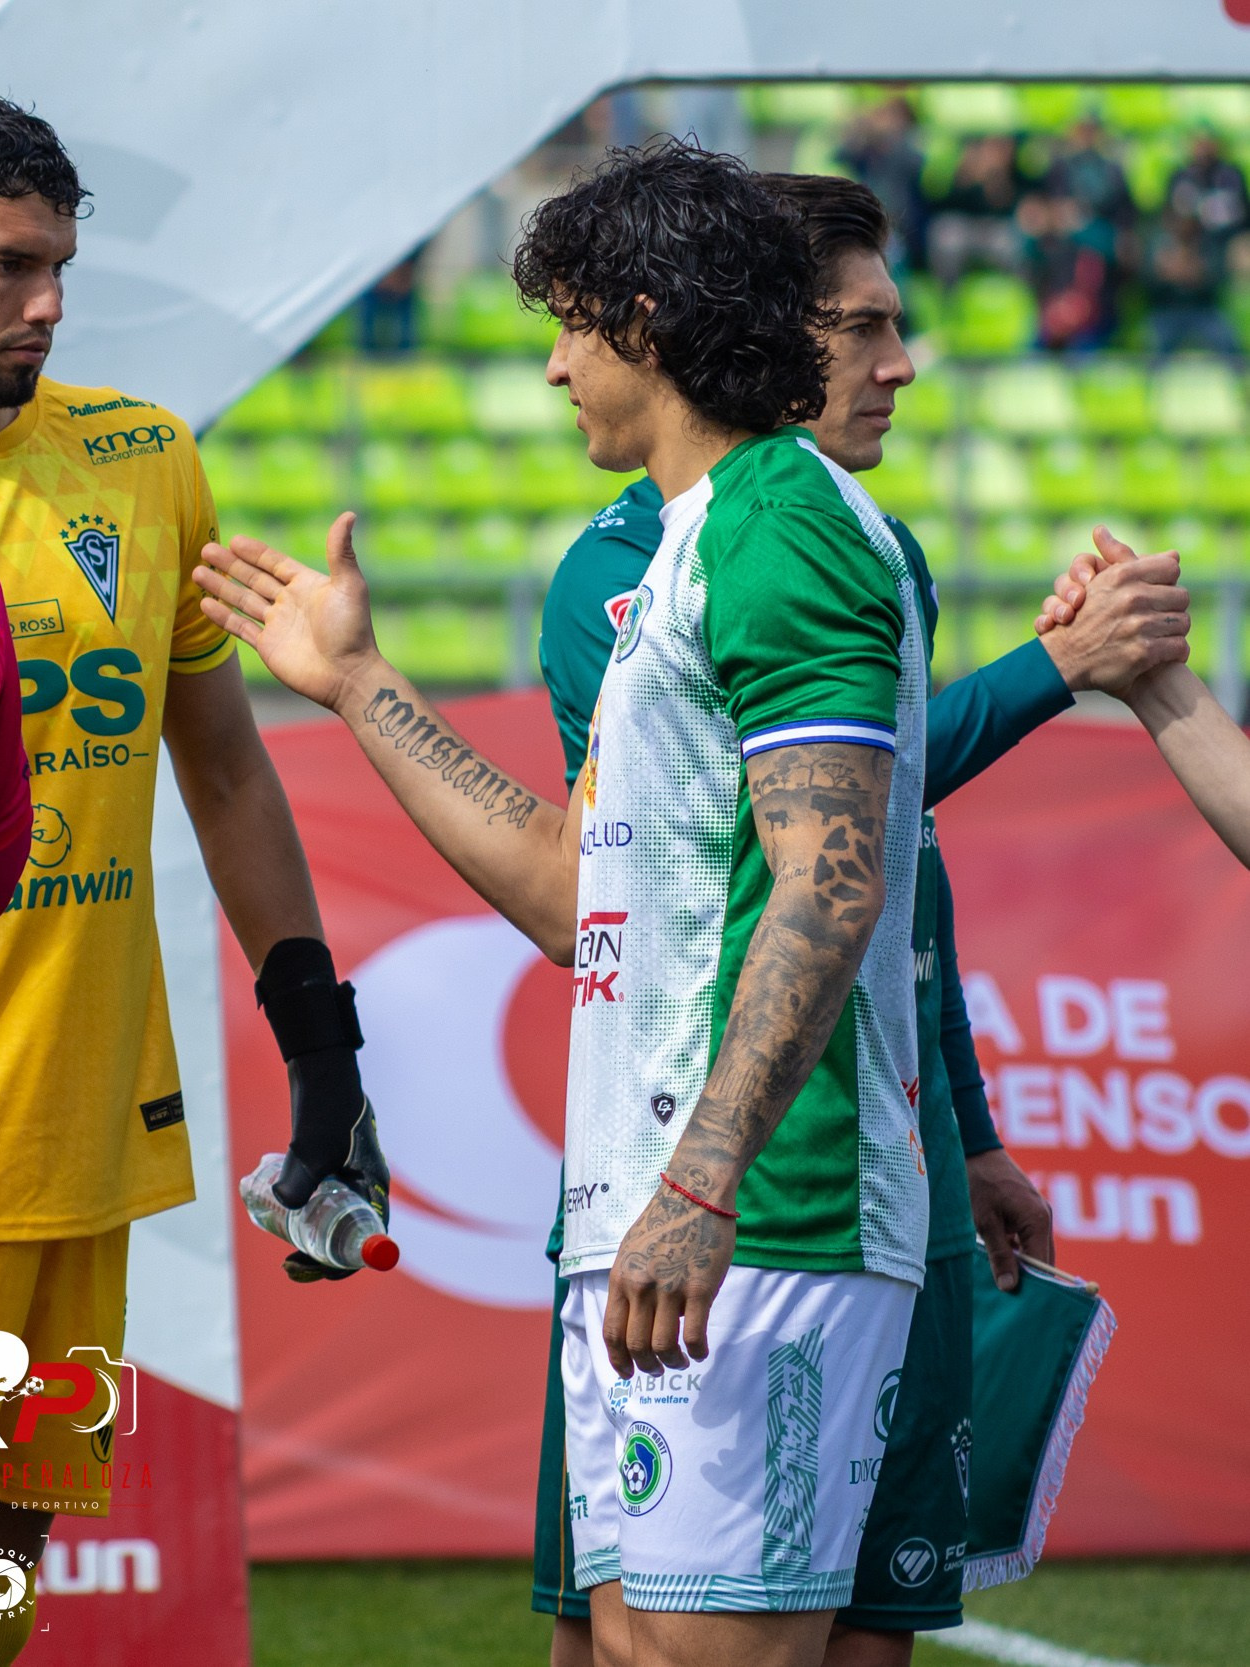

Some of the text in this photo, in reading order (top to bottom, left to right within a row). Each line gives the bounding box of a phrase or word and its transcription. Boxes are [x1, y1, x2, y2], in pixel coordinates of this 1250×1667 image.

[83, 424, 176, 456] knop
[90, 445, 159, 466] Laboratorios
[19, 616, 56, 633] ROSS
[29, 740, 130, 776] RAÍSO
[1036, 972, 1179, 1064] DE
[986, 1062, 1250, 1160] ENSO
[1032, 1167, 1203, 1246] un
[640, 1394, 690, 1405] fish welfare
